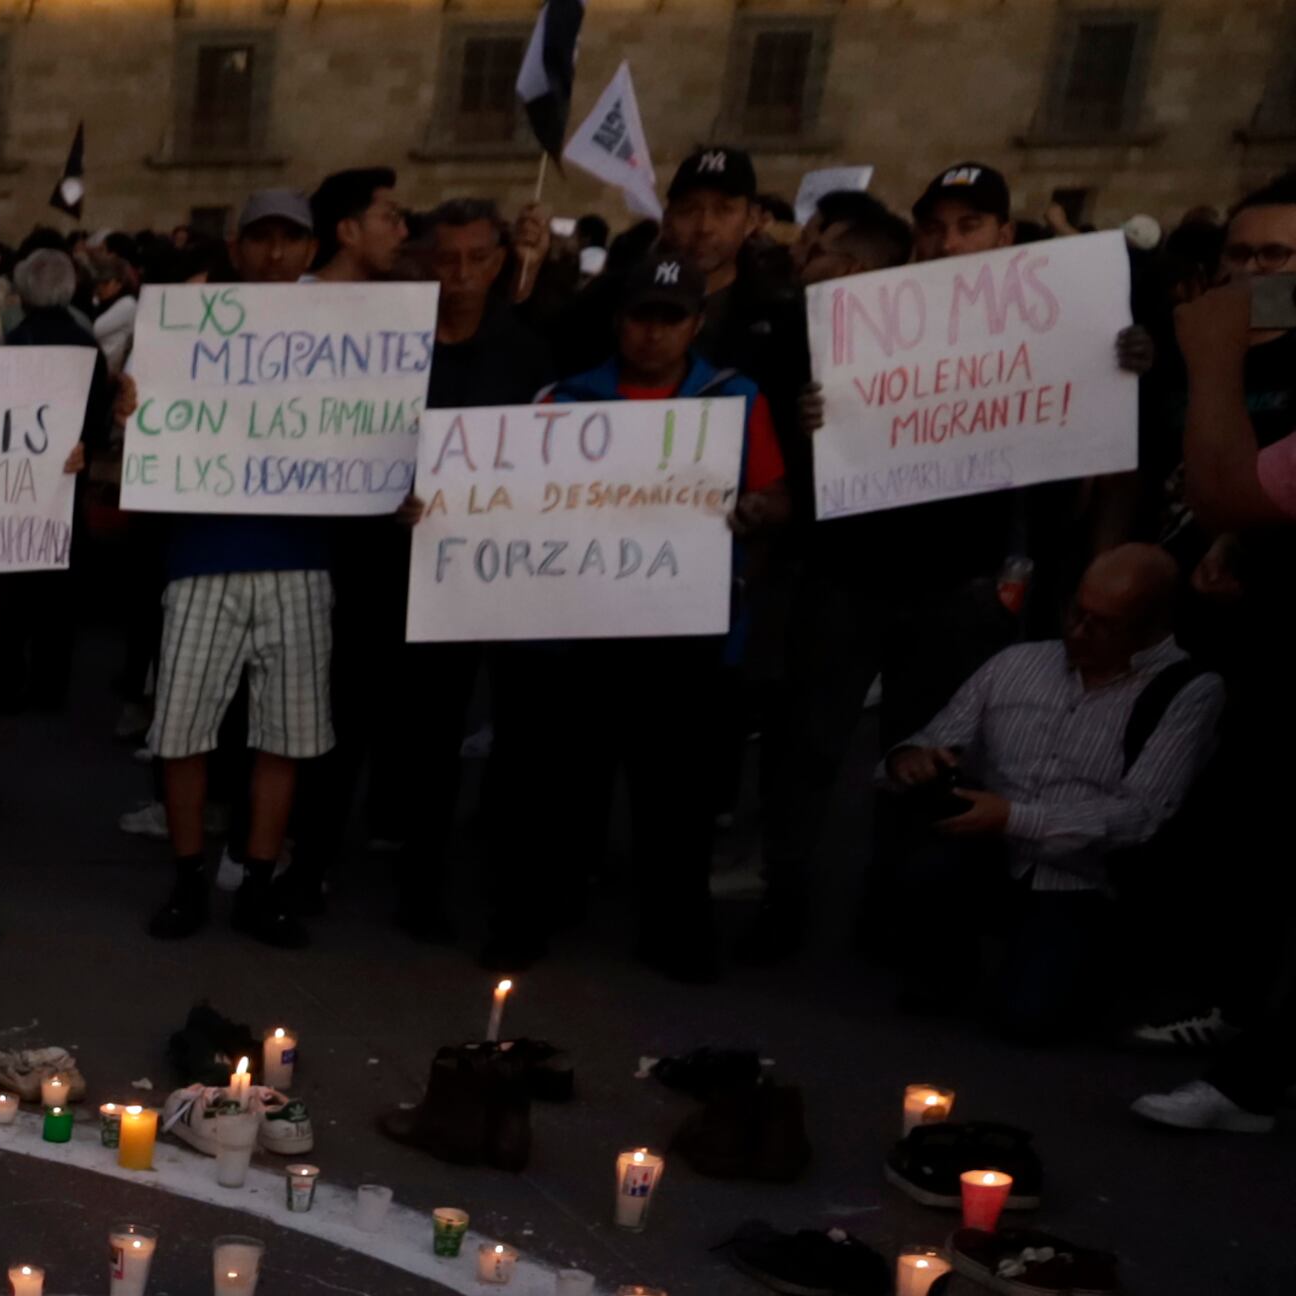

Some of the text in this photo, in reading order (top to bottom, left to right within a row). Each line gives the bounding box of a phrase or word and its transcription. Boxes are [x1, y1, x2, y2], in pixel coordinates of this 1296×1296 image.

[159, 287, 245, 337] LXS
[191, 330, 432, 386] MIGRANTES
[853, 340, 1033, 407] VIOLENCIA
[136, 396, 421, 438] CON LAS FAMILIAS
[431, 410, 613, 475] ALTO
[124, 454, 158, 486] DE
[175, 454, 236, 496] LXS
[425, 488, 448, 518] A
[468, 485, 514, 515] LA
[434, 537, 680, 583] FORZADA
